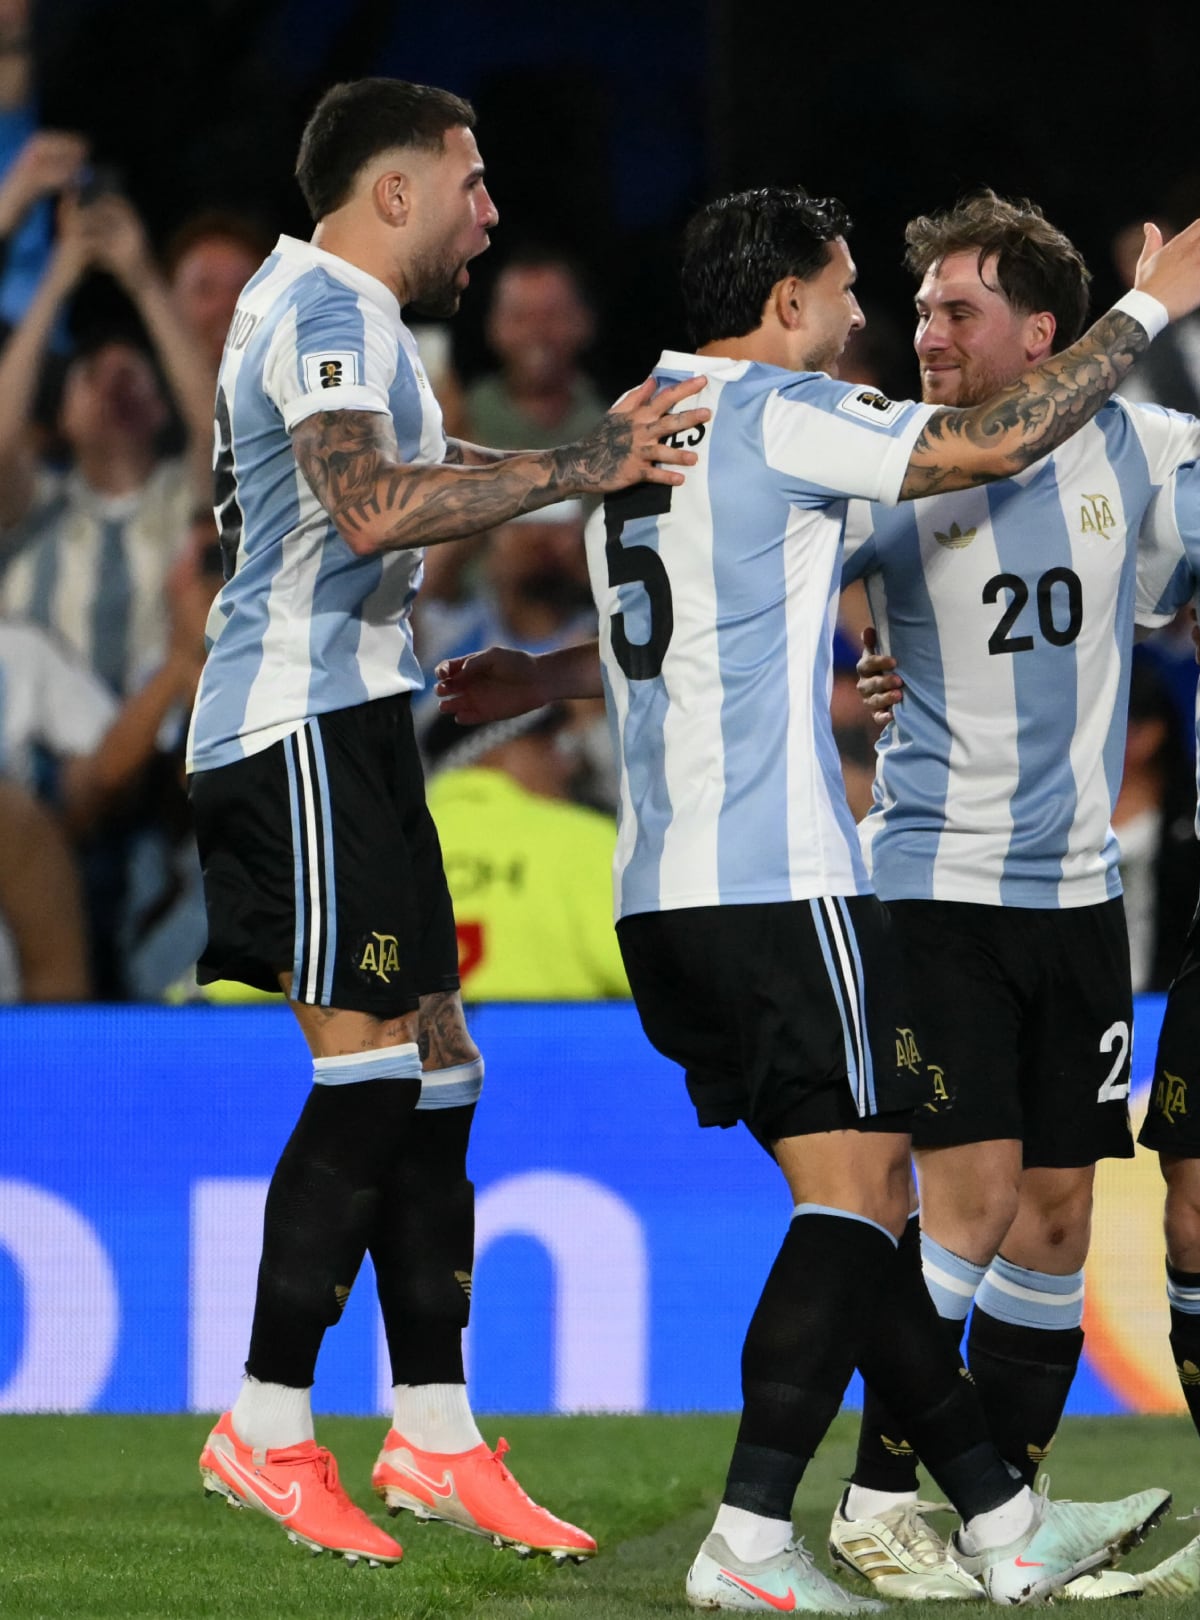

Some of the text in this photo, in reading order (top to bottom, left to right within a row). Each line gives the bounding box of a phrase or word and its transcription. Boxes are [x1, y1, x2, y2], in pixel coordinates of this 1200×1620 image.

[603, 480, 674, 681] 5
[982, 566, 1083, 655] 20
[359, 931, 401, 984] AFA
[1096, 1020, 1136, 1103] 2
